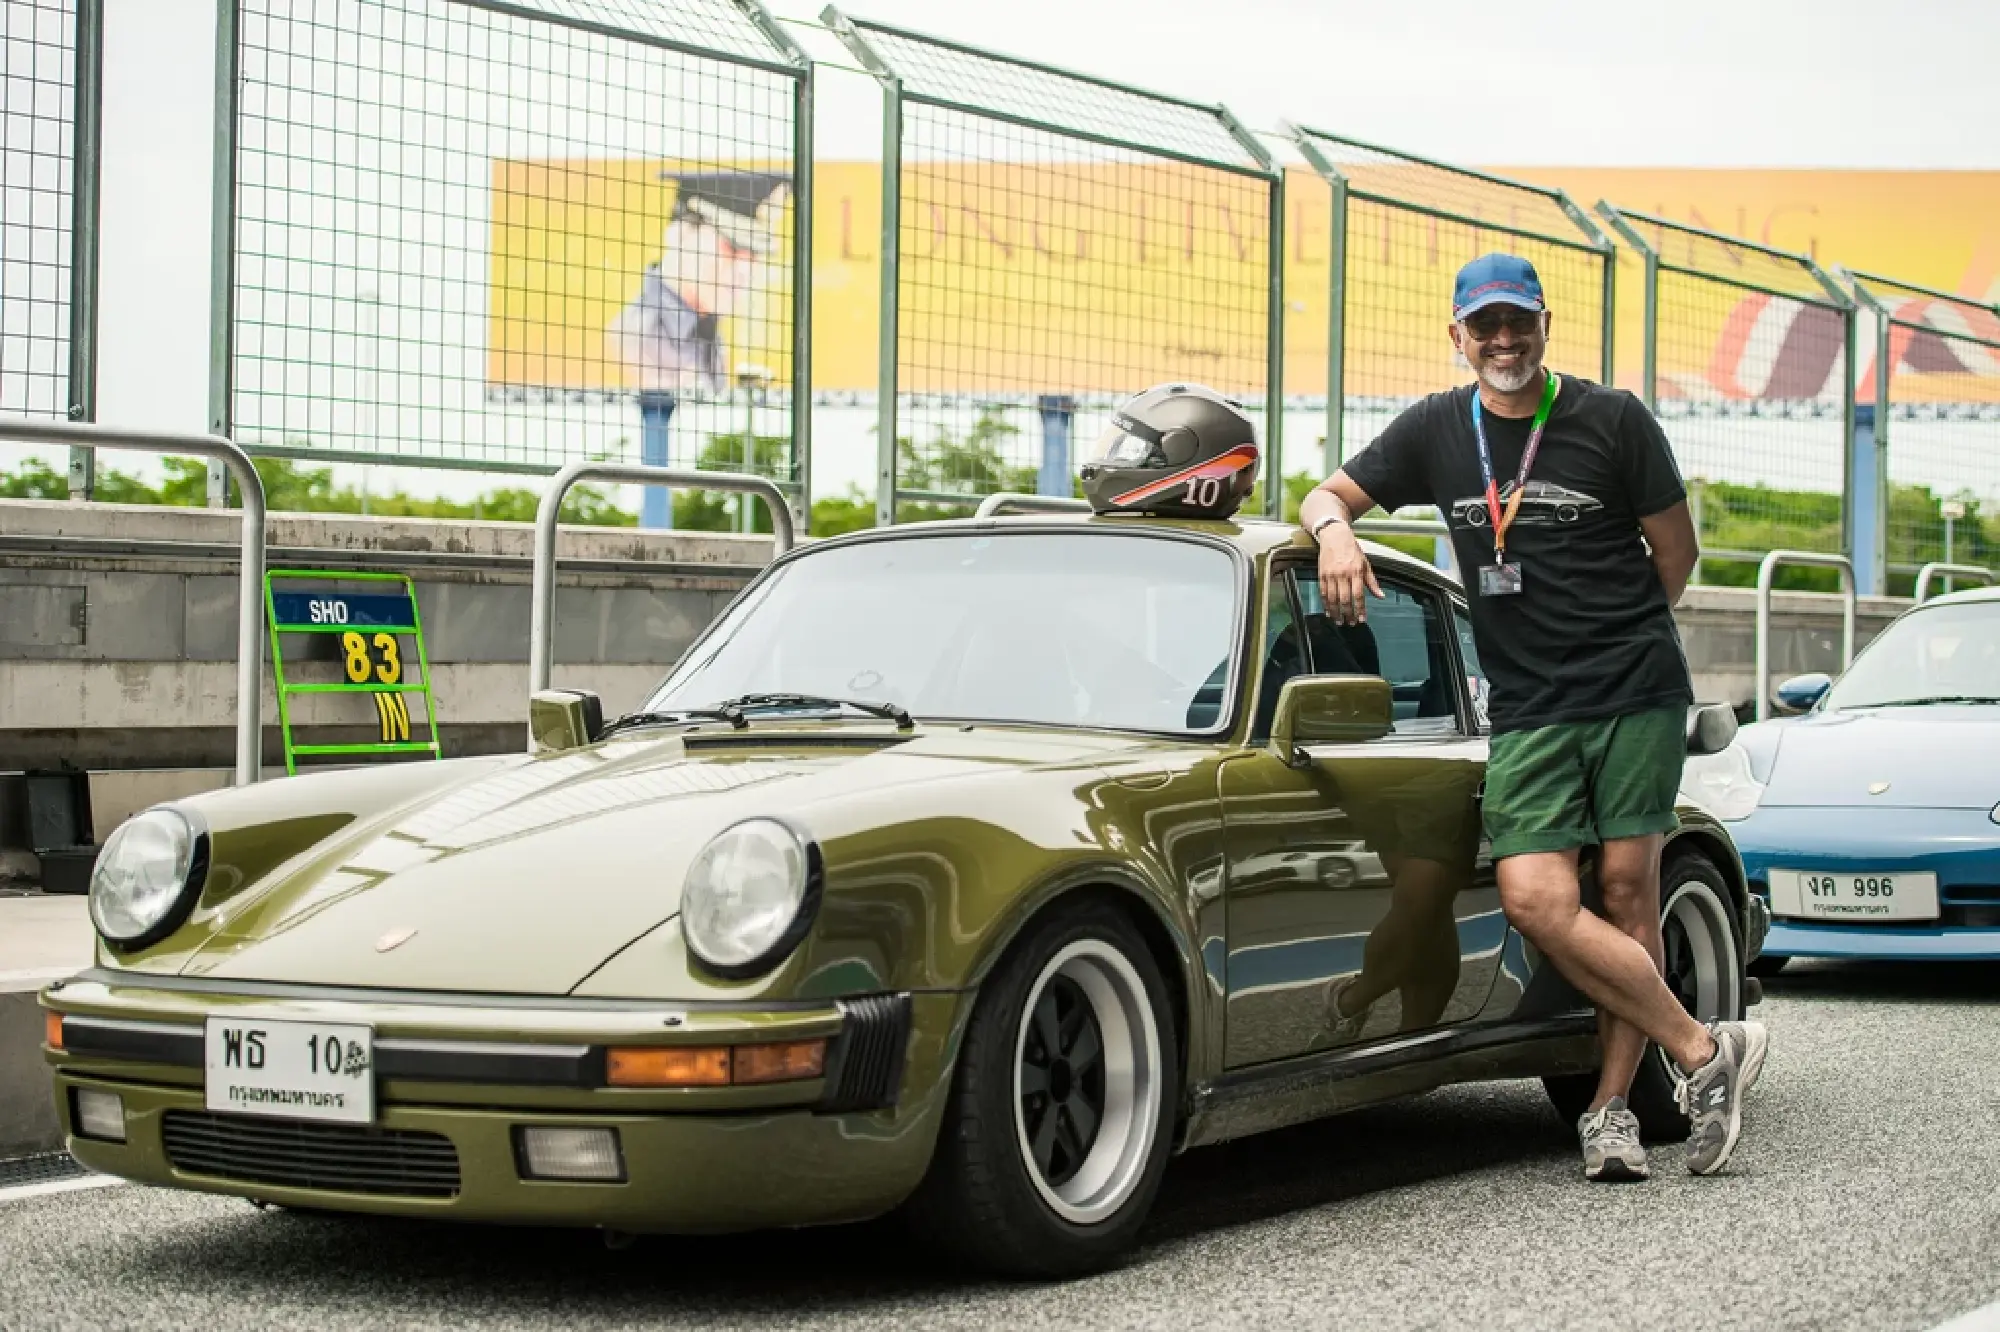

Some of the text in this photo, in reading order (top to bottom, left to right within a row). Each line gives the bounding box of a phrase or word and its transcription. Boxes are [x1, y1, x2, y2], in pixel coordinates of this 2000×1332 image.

[1181, 475, 1221, 508] 10
[309, 599, 349, 625] SHO
[343, 630, 401, 684] 83
[373, 691, 410, 742] IN
[1853, 876, 1893, 898] 996
[307, 1032, 342, 1075] 10
[228, 1083, 346, 1109] กรุงเทพมหานคร
